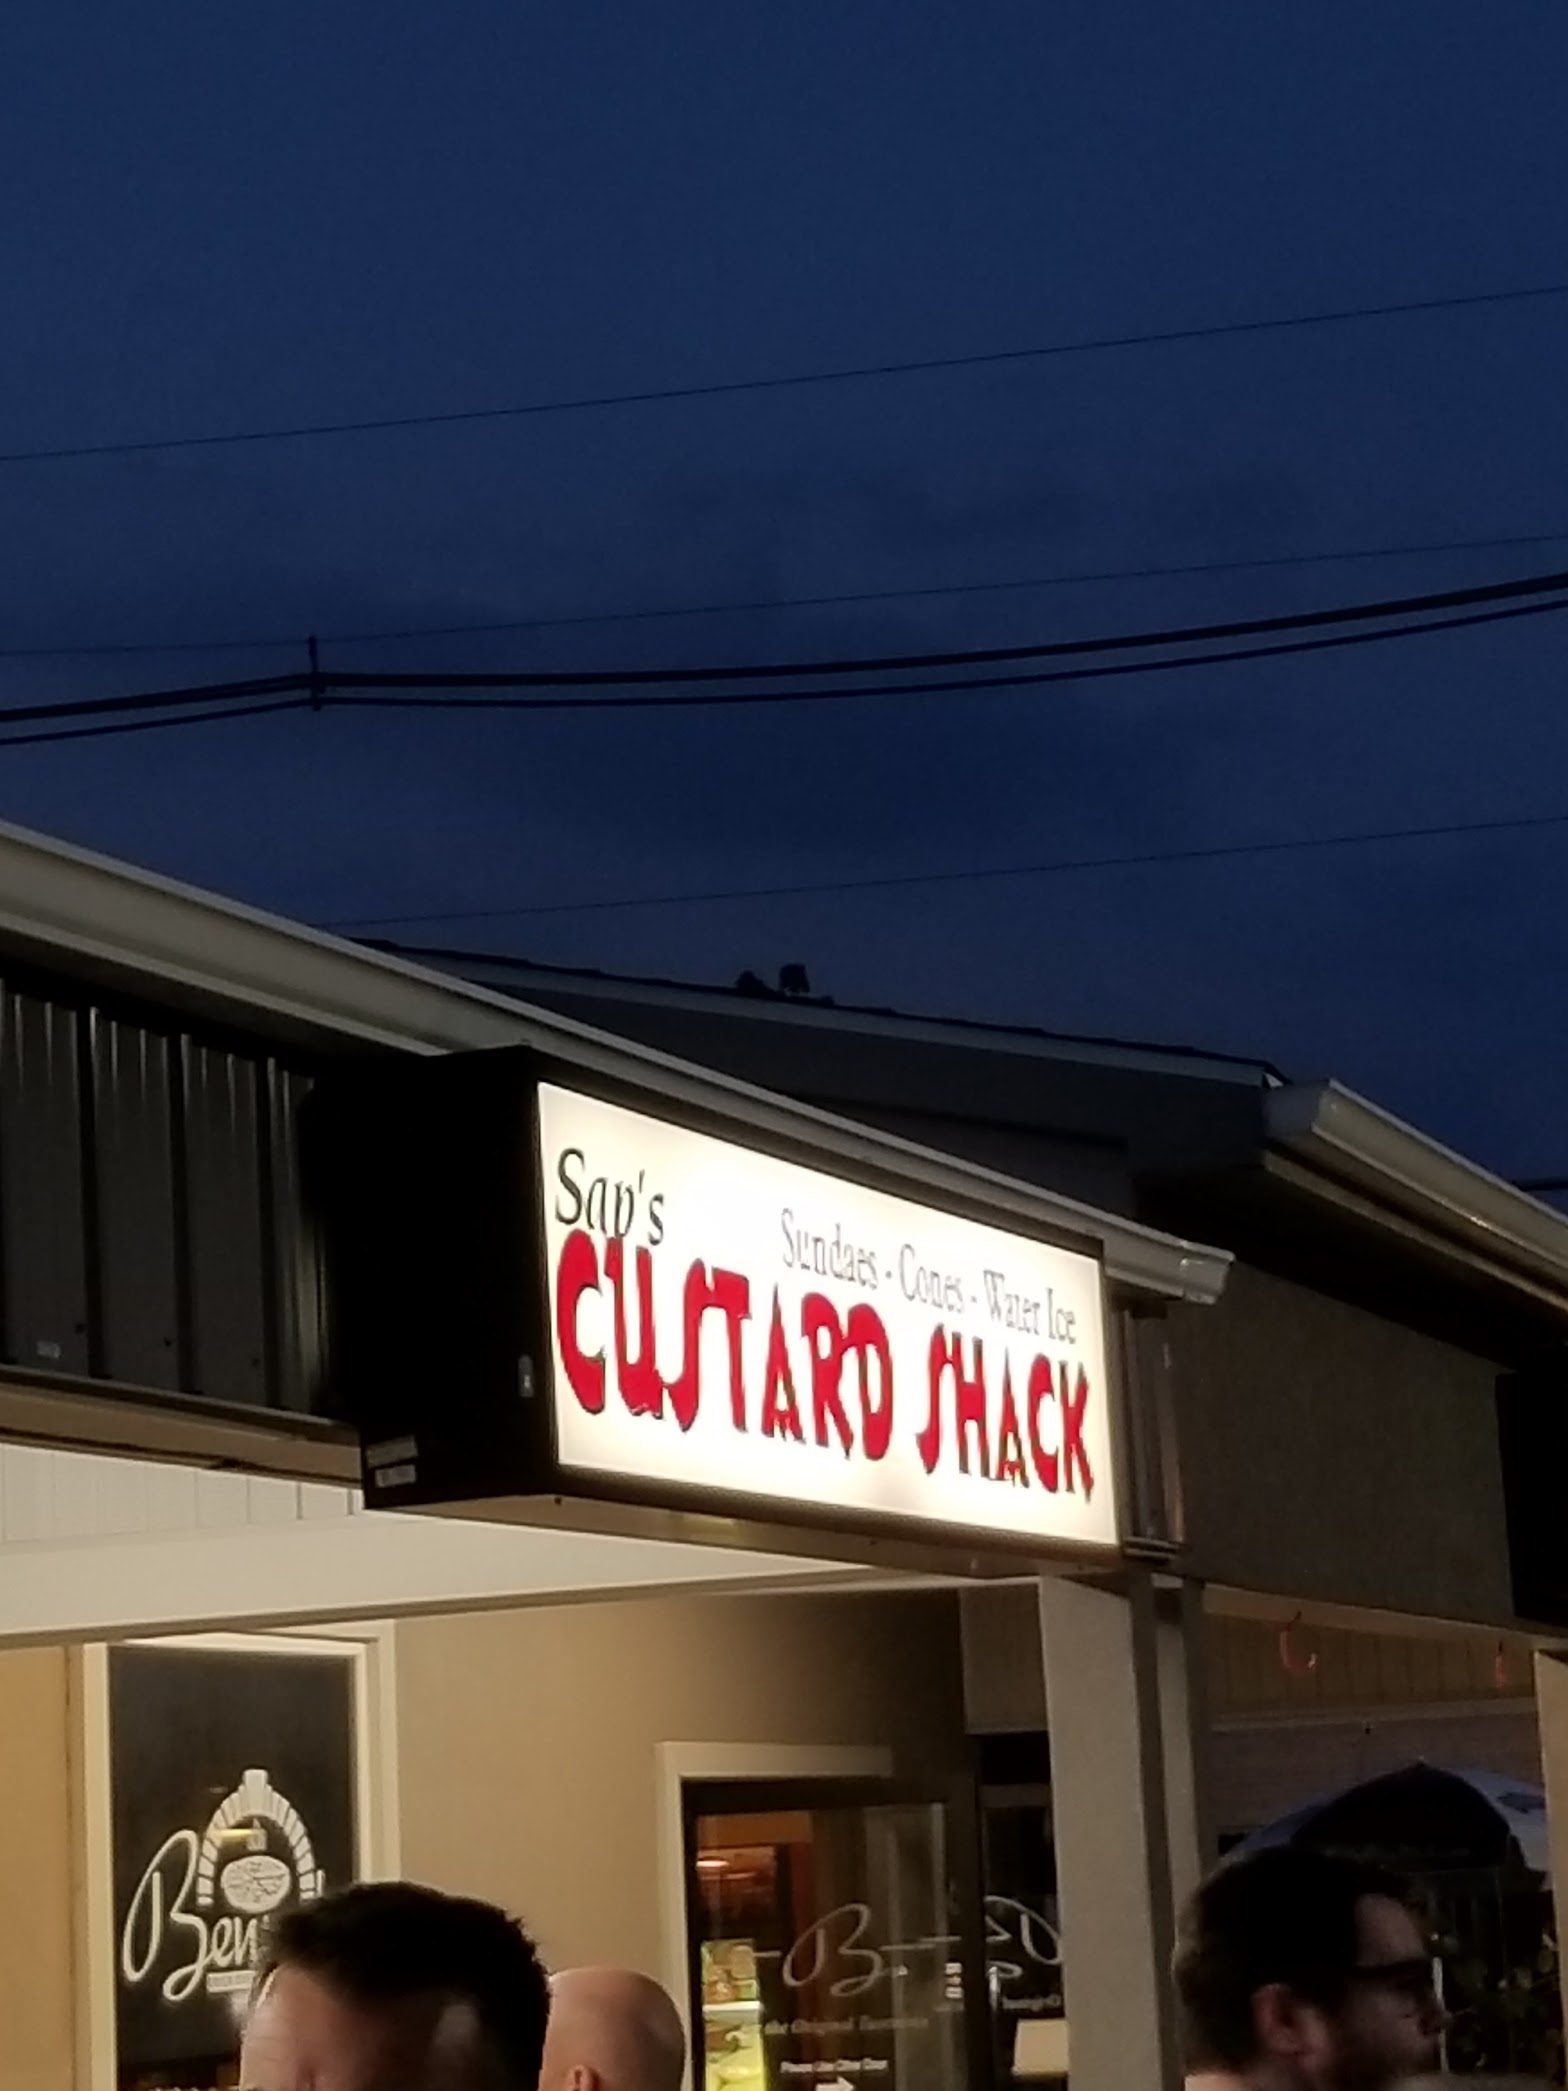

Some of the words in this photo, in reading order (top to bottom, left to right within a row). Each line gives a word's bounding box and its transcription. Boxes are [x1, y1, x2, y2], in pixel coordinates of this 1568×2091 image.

[555, 1147, 664, 1246] Sap's
[781, 1207, 878, 1290] Sundaes
[899, 1243, 964, 1314] Cones
[983, 1269, 1041, 1335] Water
[1046, 1286, 1076, 1345] Ice
[556, 1228, 893, 1462] CUSTARD
[916, 1323, 1094, 1503] SHACK
